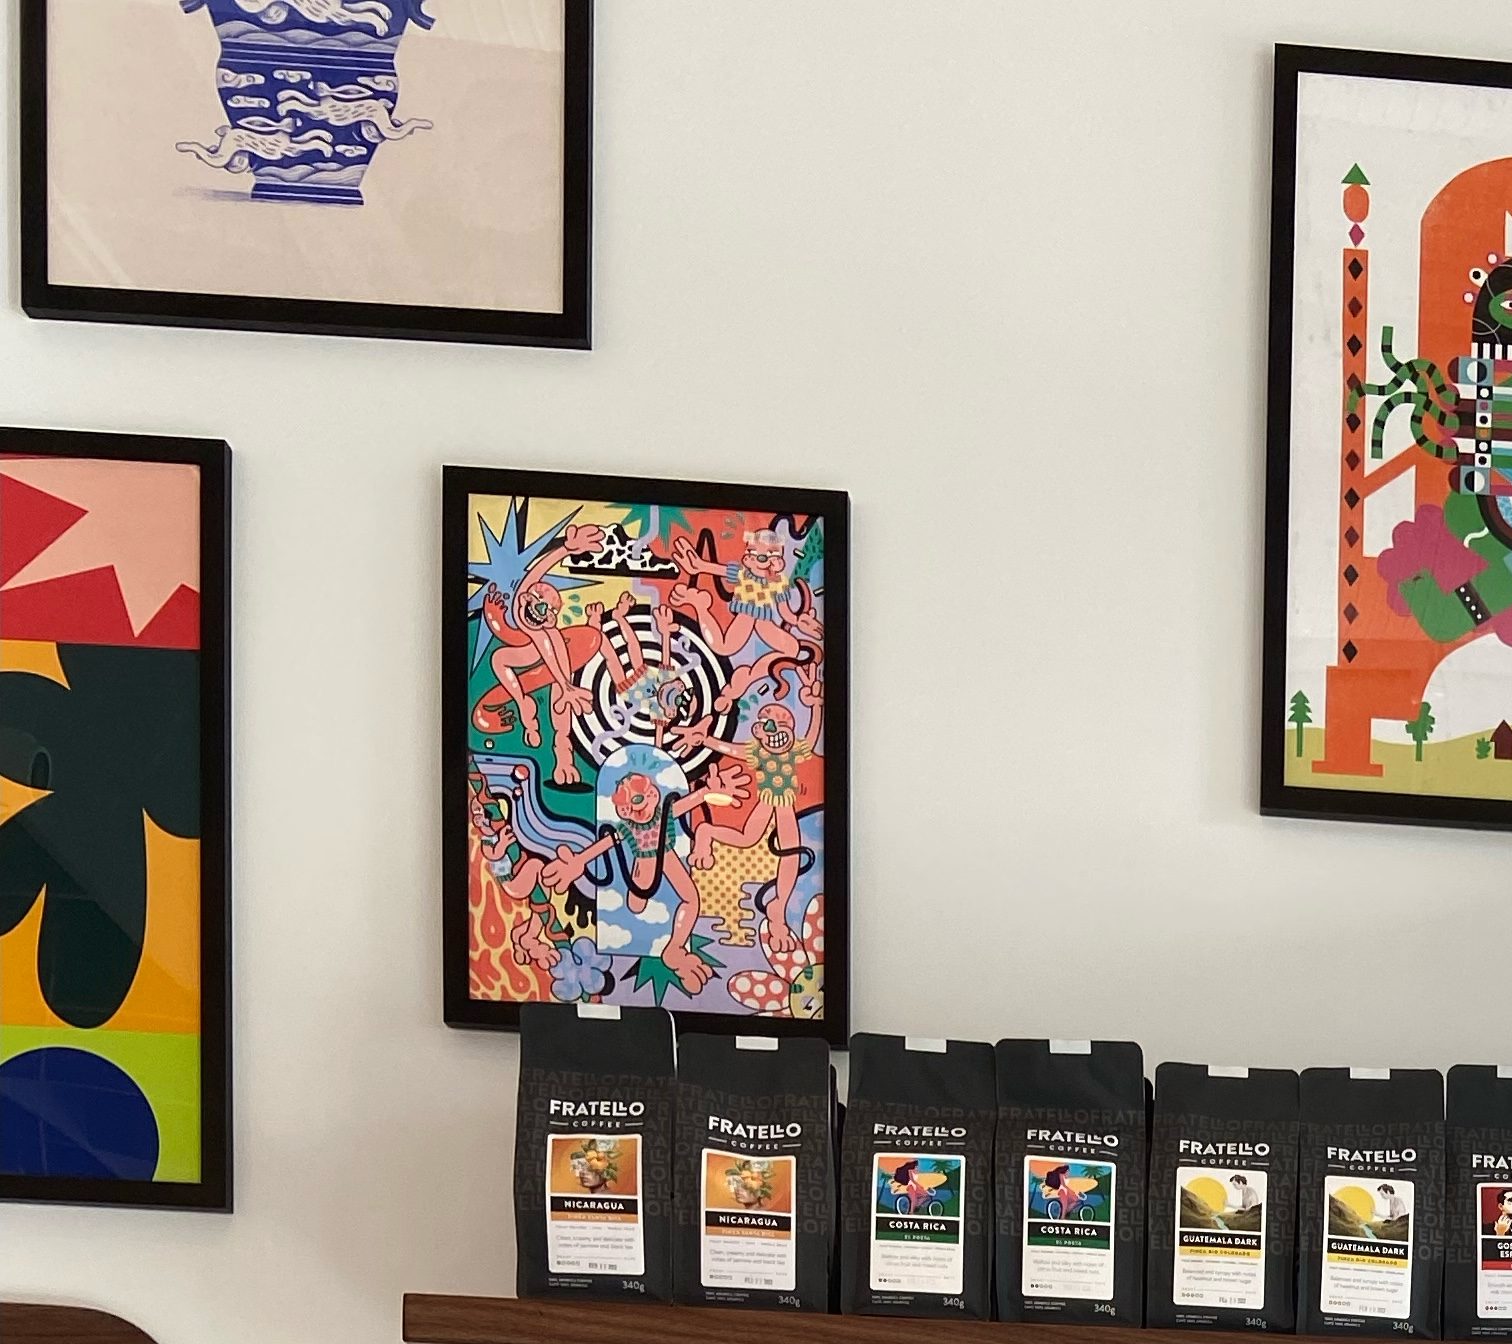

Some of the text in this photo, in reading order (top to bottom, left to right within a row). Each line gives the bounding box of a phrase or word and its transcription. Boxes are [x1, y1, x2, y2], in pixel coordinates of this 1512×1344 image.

[549, 1099, 645, 1116] FRATELLO
[572, 1120, 620, 1128] COFFEE
[708, 1115, 801, 1139] FRATELLO
[873, 1123, 967, 1137] FRATELLO
[1027, 1128, 1119, 1148] FRATELLO
[731, 1140, 779, 1150] COFFEE
[1049, 1145, 1096, 1154] COFFEE
[1179, 1139, 1270, 1156] FRATELLO
[1327, 1146, 1417, 1163] FRATELLO
[1349, 1165, 1395, 1173] COFFEE
[564, 1200, 624, 1210] NICARAGUA
[719, 1215, 778, 1227] NICARAGUA
[888, 1220, 946, 1231] COSTA RICA
[1040, 1226, 1098, 1236] COSTA RICA
[1183, 1234, 1258, 1246] GUATEMALA DARK
[1331, 1242, 1405, 1256] GUATEMALA DARK
[622, 1281, 645, 1292] 340g
[778, 1296, 800, 1307] 340g
[943, 1297, 964, 1309] 340g
[1094, 1304, 1116, 1316] 340g
[1245, 1317, 1267, 1329] 340g
[1392, 1321, 1414, 1334] 340g
